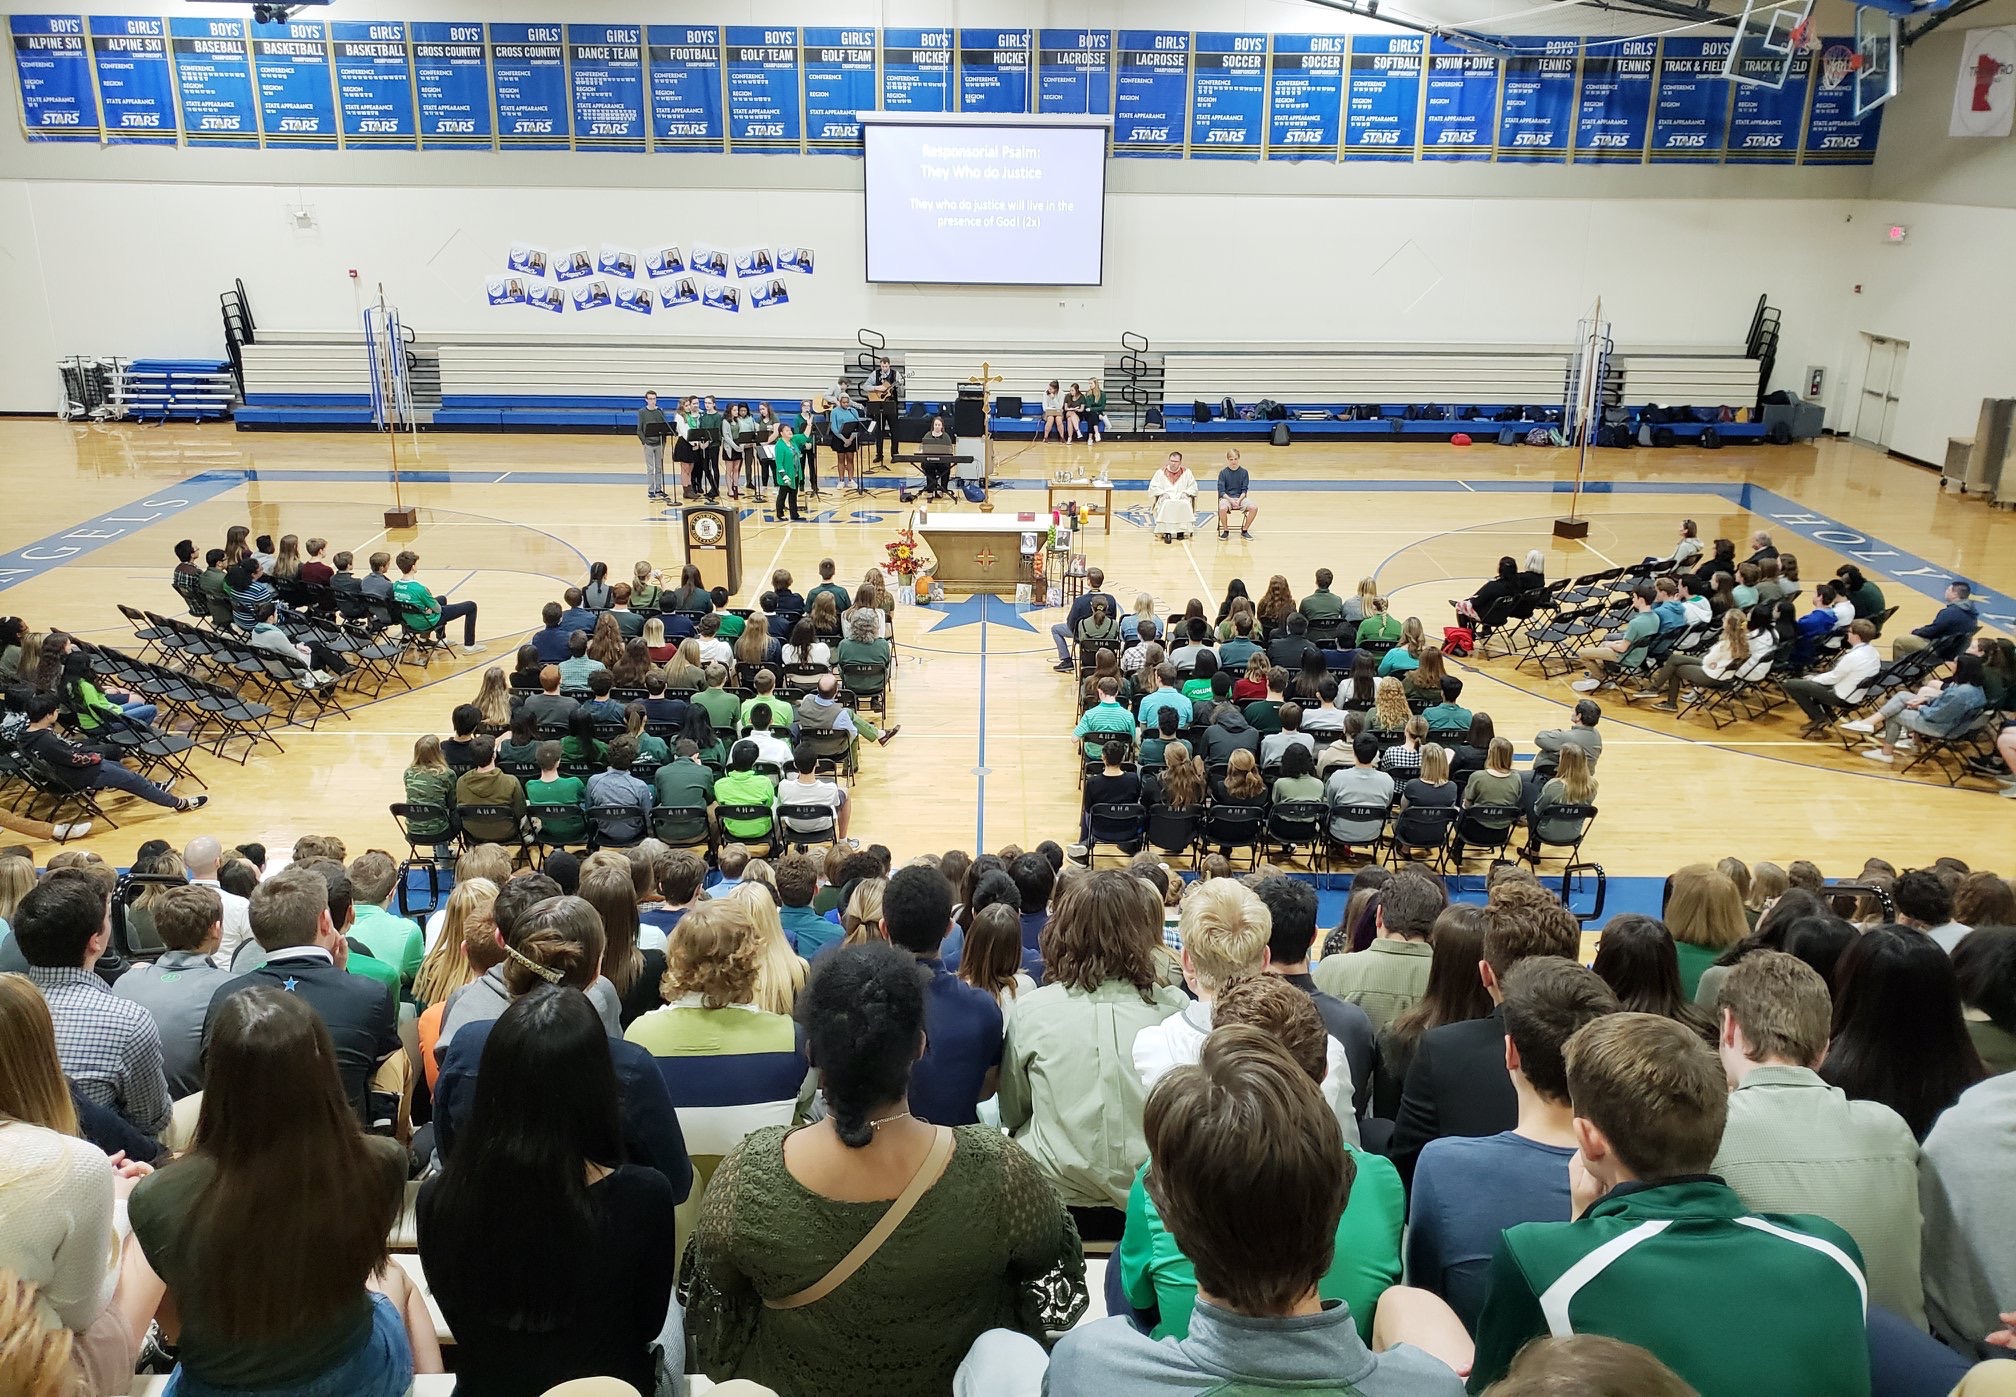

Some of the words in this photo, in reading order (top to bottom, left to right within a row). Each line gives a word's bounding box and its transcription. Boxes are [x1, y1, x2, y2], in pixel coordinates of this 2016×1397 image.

[51, 20, 80, 33] BOYS'
[128, 21, 160, 34] GIRLS'
[211, 23, 241, 36] BOYS'
[291, 25, 321, 38] BOYS'
[370, 27, 402, 40] GIRLS'
[451, 28, 480, 41] BOYS'
[528, 28, 560, 42] GIRLS'
[606, 30, 639, 43] GIRLS'
[687, 30, 716, 44] BOYS'
[765, 32, 795, 44] BOYS'
[841, 32, 874, 45] GIRLS'
[29, 38, 62, 50] ALPINE
[64, 38, 82, 49] SKI
[109, 39, 142, 51] ALPINE
[144, 40, 162, 51] SKI
[922, 34, 950, 46] BOYS'
[998, 34, 1031, 46] GIRLS'
[1079, 35, 1108, 48] BOYS'
[1155, 36, 1188, 49] GIRLS'
[1234, 38, 1265, 50] BOYS'
[1311, 39, 1344, 52] GIRLS'
[1389, 40, 1422, 52] GIRLS'
[194, 41, 244, 53] BASEBALL
[264, 43, 324, 56] BASKETBALL
[346, 44, 405, 56] BASKETBALL
[418, 46, 442, 56] CROSS
[444, 46, 481, 57] COUNTRY
[496, 46, 522, 57] CROSS
[524, 47, 561, 58] COUNTRY
[1546, 42, 1577, 54] BOYS'
[1623, 42, 1656, 54] GIRLS'
[578, 48, 609, 58] DANCE
[612, 48, 638, 60] TEAM
[670, 48, 718, 60] FOOTBALL
[740, 49, 765, 60] GOLF
[767, 50, 793, 60] TEAM
[822, 50, 846, 62] GOLF
[848, 50, 872, 62] TEAM
[912, 52, 950, 63] HOCKEY
[994, 53, 1030, 64] HOCKEY
[1058, 53, 1106, 64] LACROSSE
[1136, 54, 1184, 66] LACROSSE
[1222, 56, 1261, 67] SOCCER
[1302, 56, 1340, 68] SOCCER
[1374, 56, 1420, 69] SOFTBALL
[1436, 58, 1462, 70] SWIM
[1472, 58, 1494, 69] DIVE
[1538, 59, 1572, 70] TENNIS
[1617, 60, 1650, 71] TENNIS
[1665, 61, 1692, 71] TRACK
[1745, 61, 1772, 71] TRACK
[42, 114, 80, 124] STARS
[121, 114, 160, 126] STARS
[200, 118, 240, 130] STARS
[279, 119, 318, 130] STARS
[358, 121, 398, 132] STARS
[436, 122, 475, 132] STARS
[513, 122, 552, 132] STARS
[590, 123, 629, 134] STARS
[668, 124, 708, 135] STARS
[745, 125, 784, 136] STARS
[821, 126, 860, 136] STARS
[1128, 130, 1168, 140] STARS
[1206, 131, 1246, 142] STARS
[1284, 132, 1323, 142] STARS
[1360, 132, 1400, 144] STARS
[1438, 132, 1476, 142] STARS
[1513, 134, 1552, 145] STARS
[1590, 135, 1630, 146] STARS
[1666, 136, 1706, 146] STARS
[1742, 136, 1783, 146] STARS
[1820, 136, 1862, 148] STARS
[922, 144, 998, 160] Responsorial
[1002, 146, 1040, 158] Psalm:
[921, 165, 950, 181] They
[953, 166, 980, 178] Who
[984, 166, 1000, 178] do
[1002, 168, 1042, 179] Justice
[910, 199, 934, 212] They
[936, 200, 956, 210] who
[959, 200, 972, 210] do
[973, 200, 1005, 212] justice
[1008, 200, 1024, 210] will
[1028, 201, 1044, 210] live
[1047, 201, 1056, 210] in
[1058, 201, 1074, 211] the
[938, 217, 981, 228] presence
[984, 216, 994, 226] of
[1022, 216, 1040, 228] (2x)
[1770, 512, 1952, 580] HOLY
